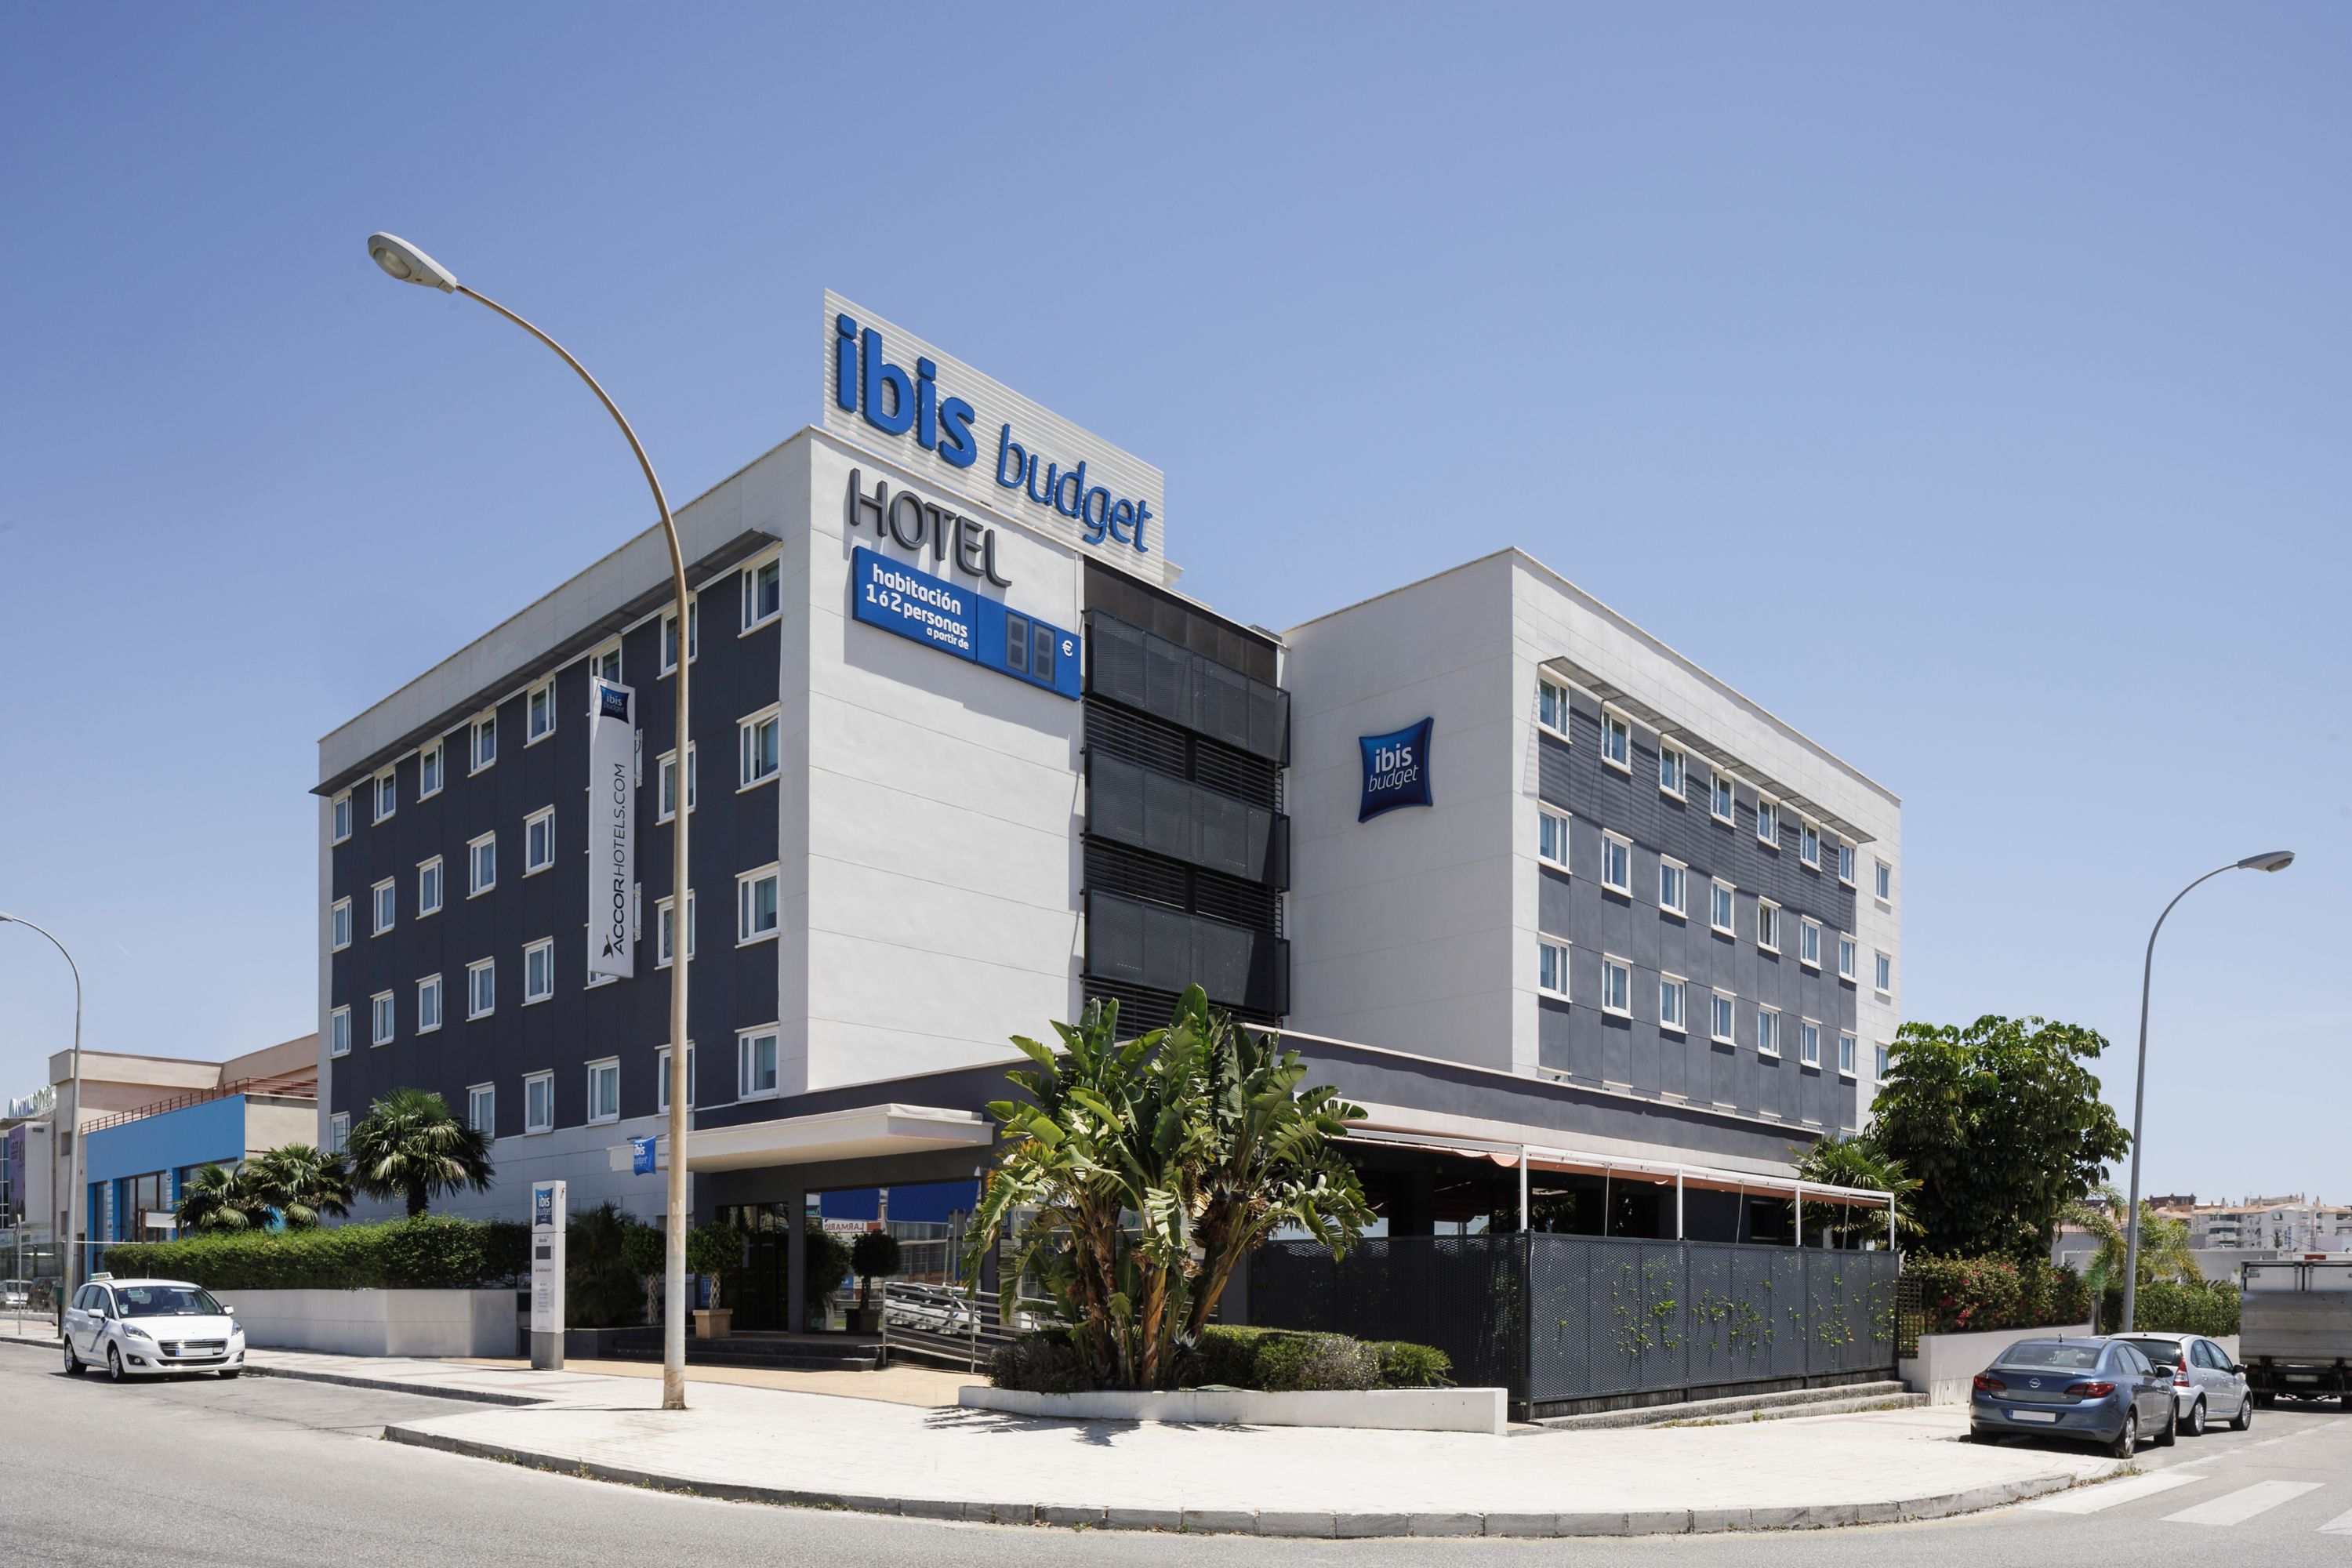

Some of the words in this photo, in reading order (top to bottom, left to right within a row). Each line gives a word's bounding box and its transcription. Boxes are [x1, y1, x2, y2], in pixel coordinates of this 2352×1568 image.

[836, 313, 978, 469] ibis
[996, 423, 1153, 553] budget
[849, 468, 1012, 588] HOTEL
[873, 563, 962, 616] habitación
[866, 583, 877, 604] 1
[879, 590, 889, 608] ó
[890, 592, 902, 613] 2
[903, 602, 968, 638] personas
[926, 627, 933, 637] a
[933, 630, 957, 645] partir
[957, 637, 970, 650] de
[1062, 640, 1073, 657] €
[606, 693, 622, 706] ibis
[1375, 742, 1413, 774] ibis
[1368, 764, 1419, 793] budget
[613, 763, 626, 956] ACCORHOTELS.COM
[538, 1194, 550, 1208] ibis
